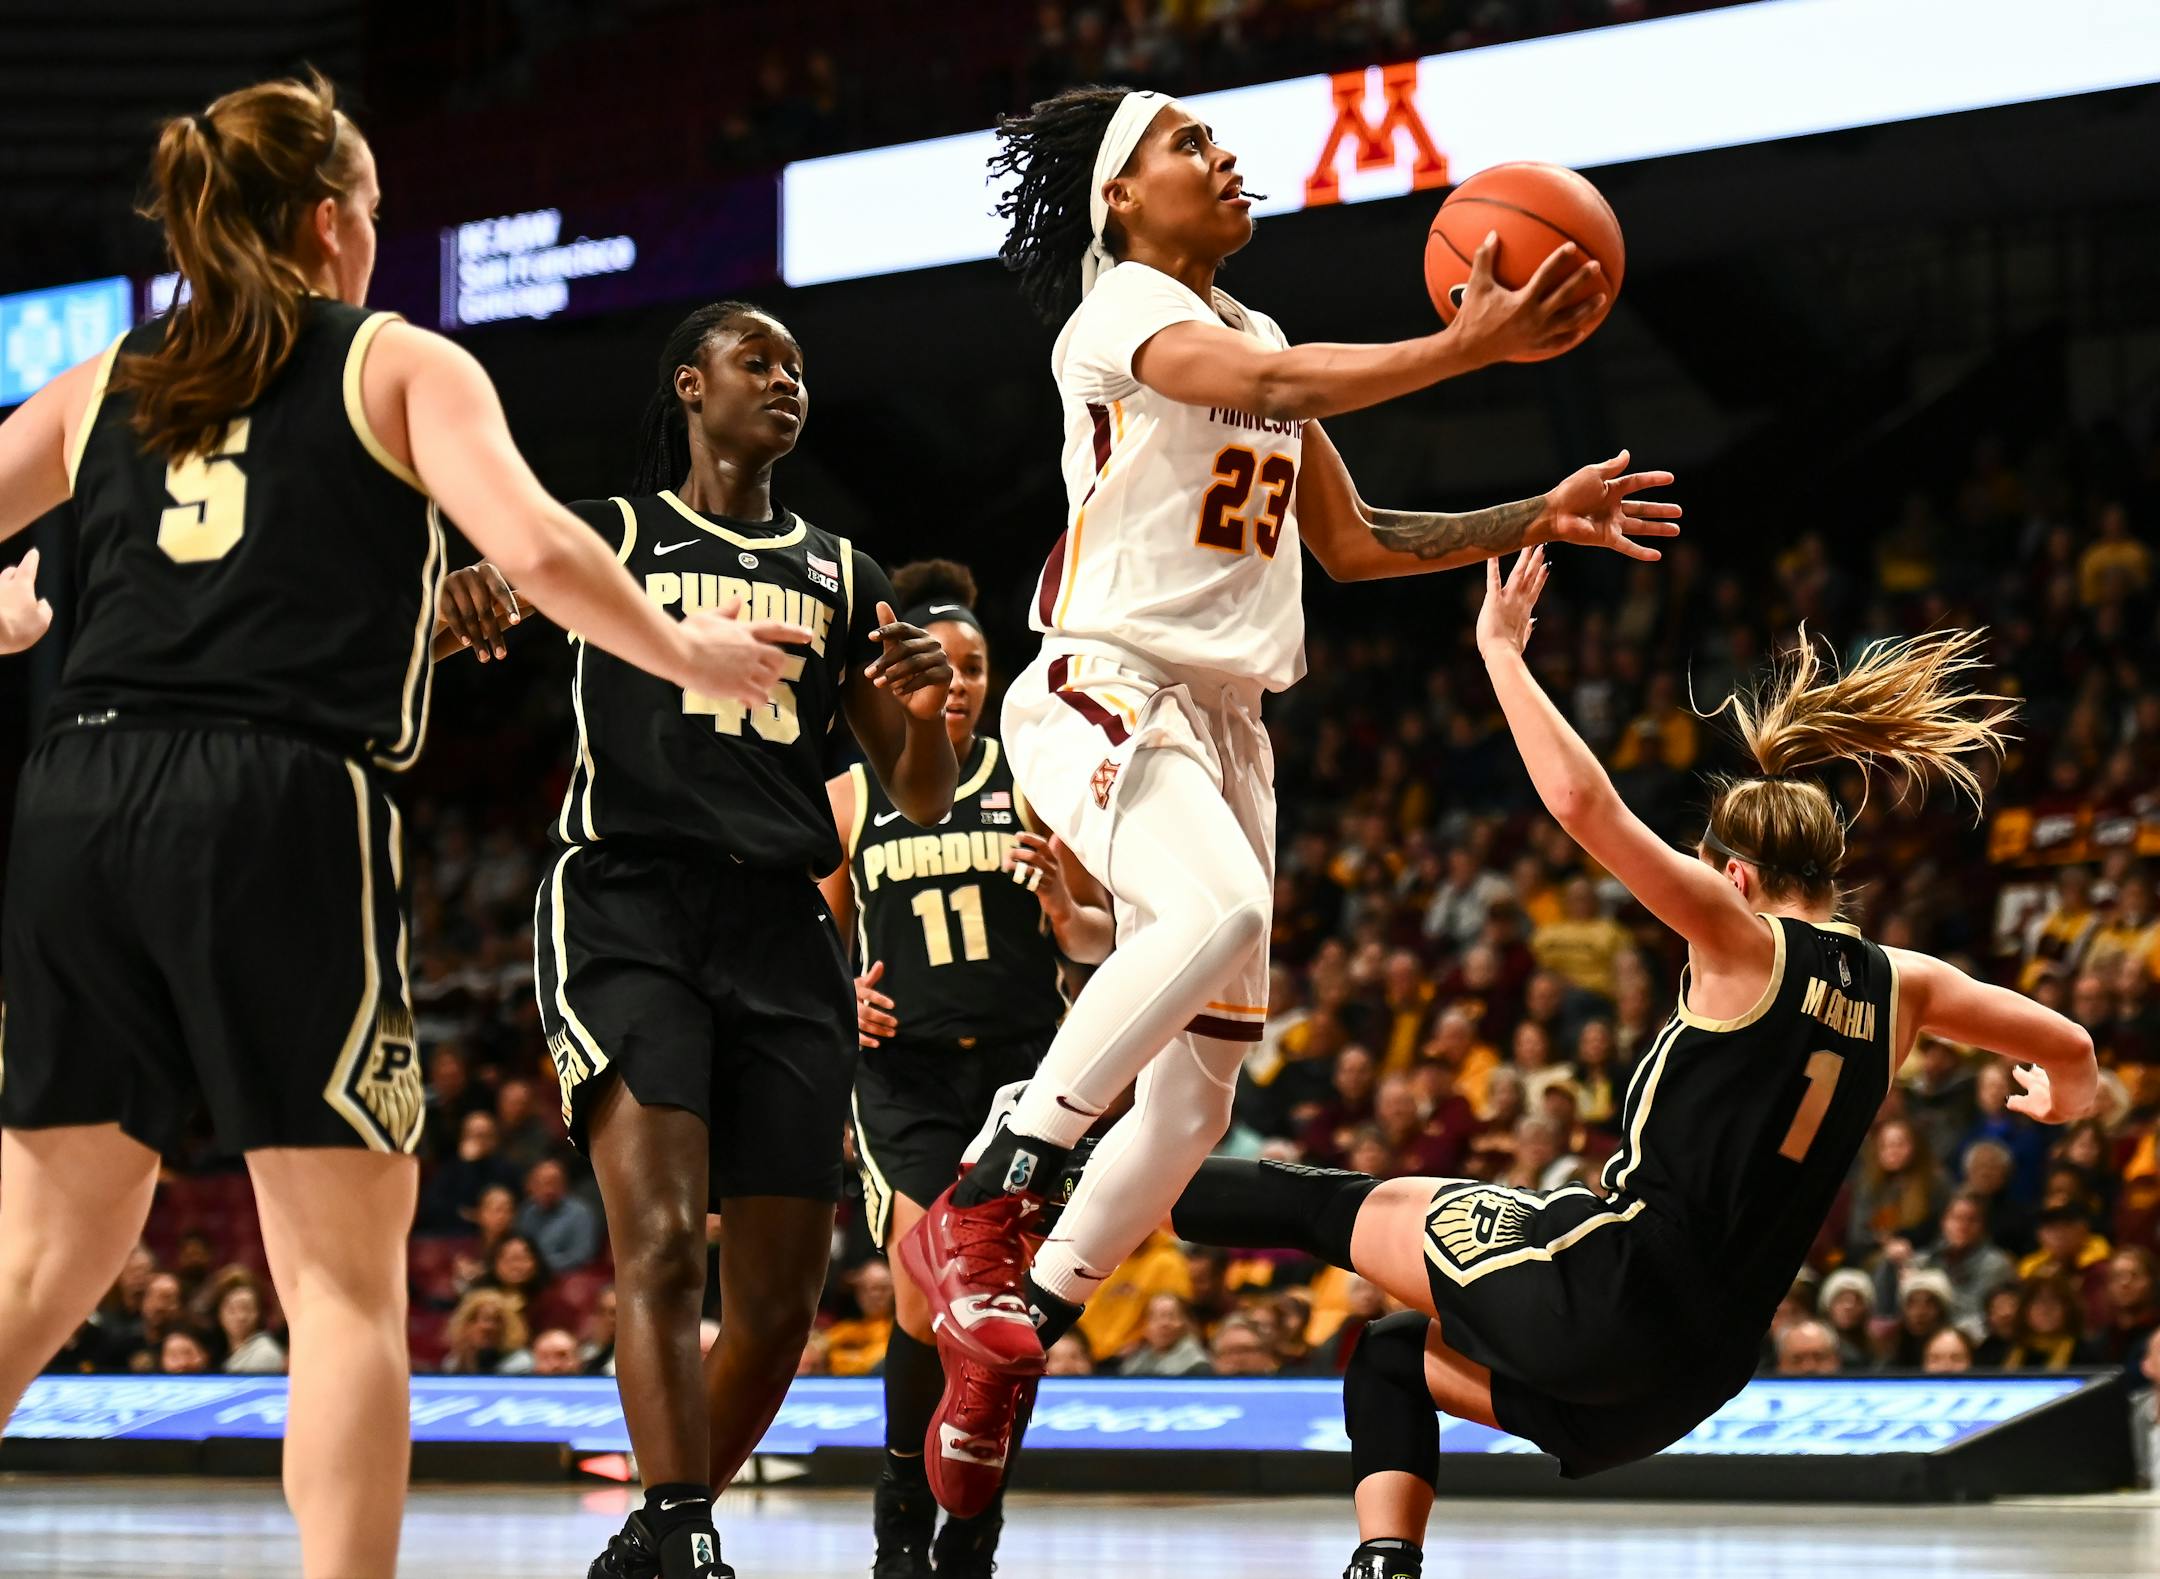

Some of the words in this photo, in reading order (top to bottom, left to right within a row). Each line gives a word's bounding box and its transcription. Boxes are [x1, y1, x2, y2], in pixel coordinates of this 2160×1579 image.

[1305, 62, 1450, 207] M
[156, 417, 250, 565] 5
[1195, 443, 1295, 560] 23
[911, 884, 990, 967] 11
[371, 1041, 411, 1081] P
[1777, 1049, 1845, 1164] 1
